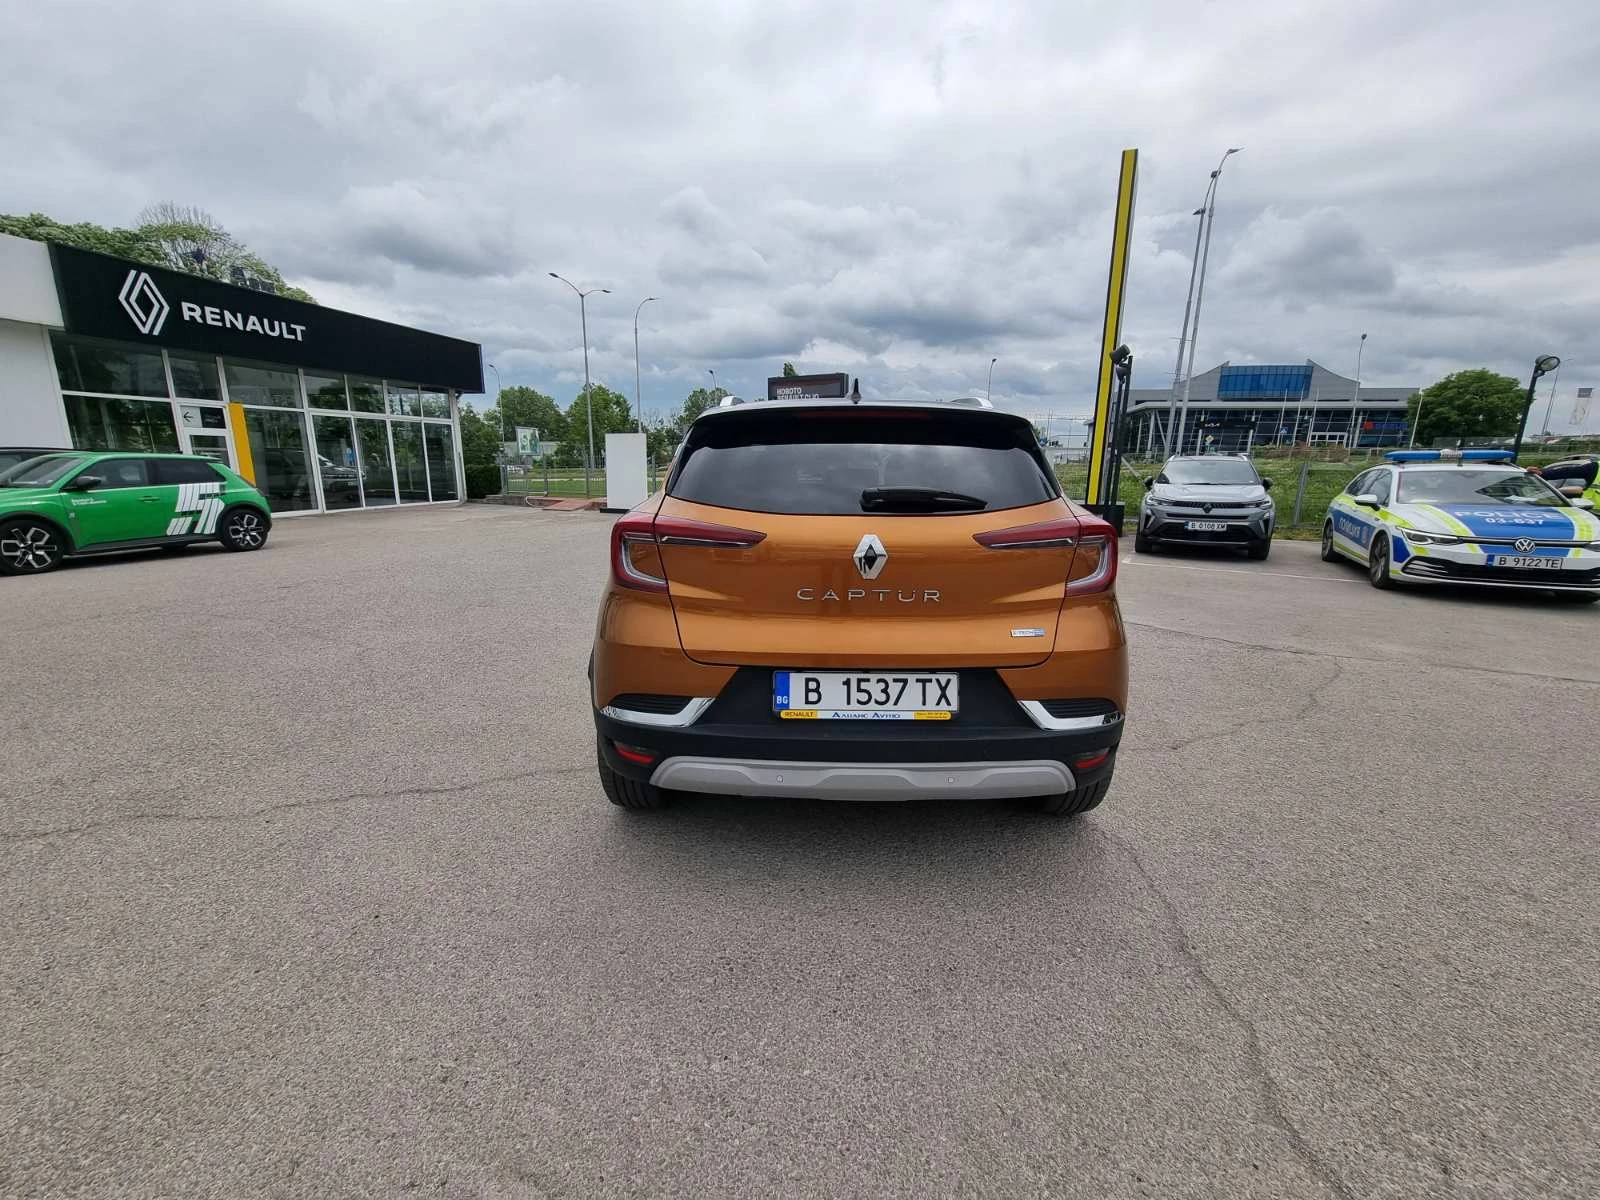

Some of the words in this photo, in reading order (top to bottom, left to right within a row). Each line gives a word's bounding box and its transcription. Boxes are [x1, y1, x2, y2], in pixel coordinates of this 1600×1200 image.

[181, 300, 307, 342] RENAULT
[1499, 556, 1507, 565] B
[1513, 557, 1542, 567] 9122
[1543, 558, 1560, 568] TE
[796, 588, 941, 603] CAPTUR
[804, 677, 822, 705] B
[842, 677, 909, 706] 1537
[915, 677, 952, 706] TX
[775, 695, 788, 704] BG
